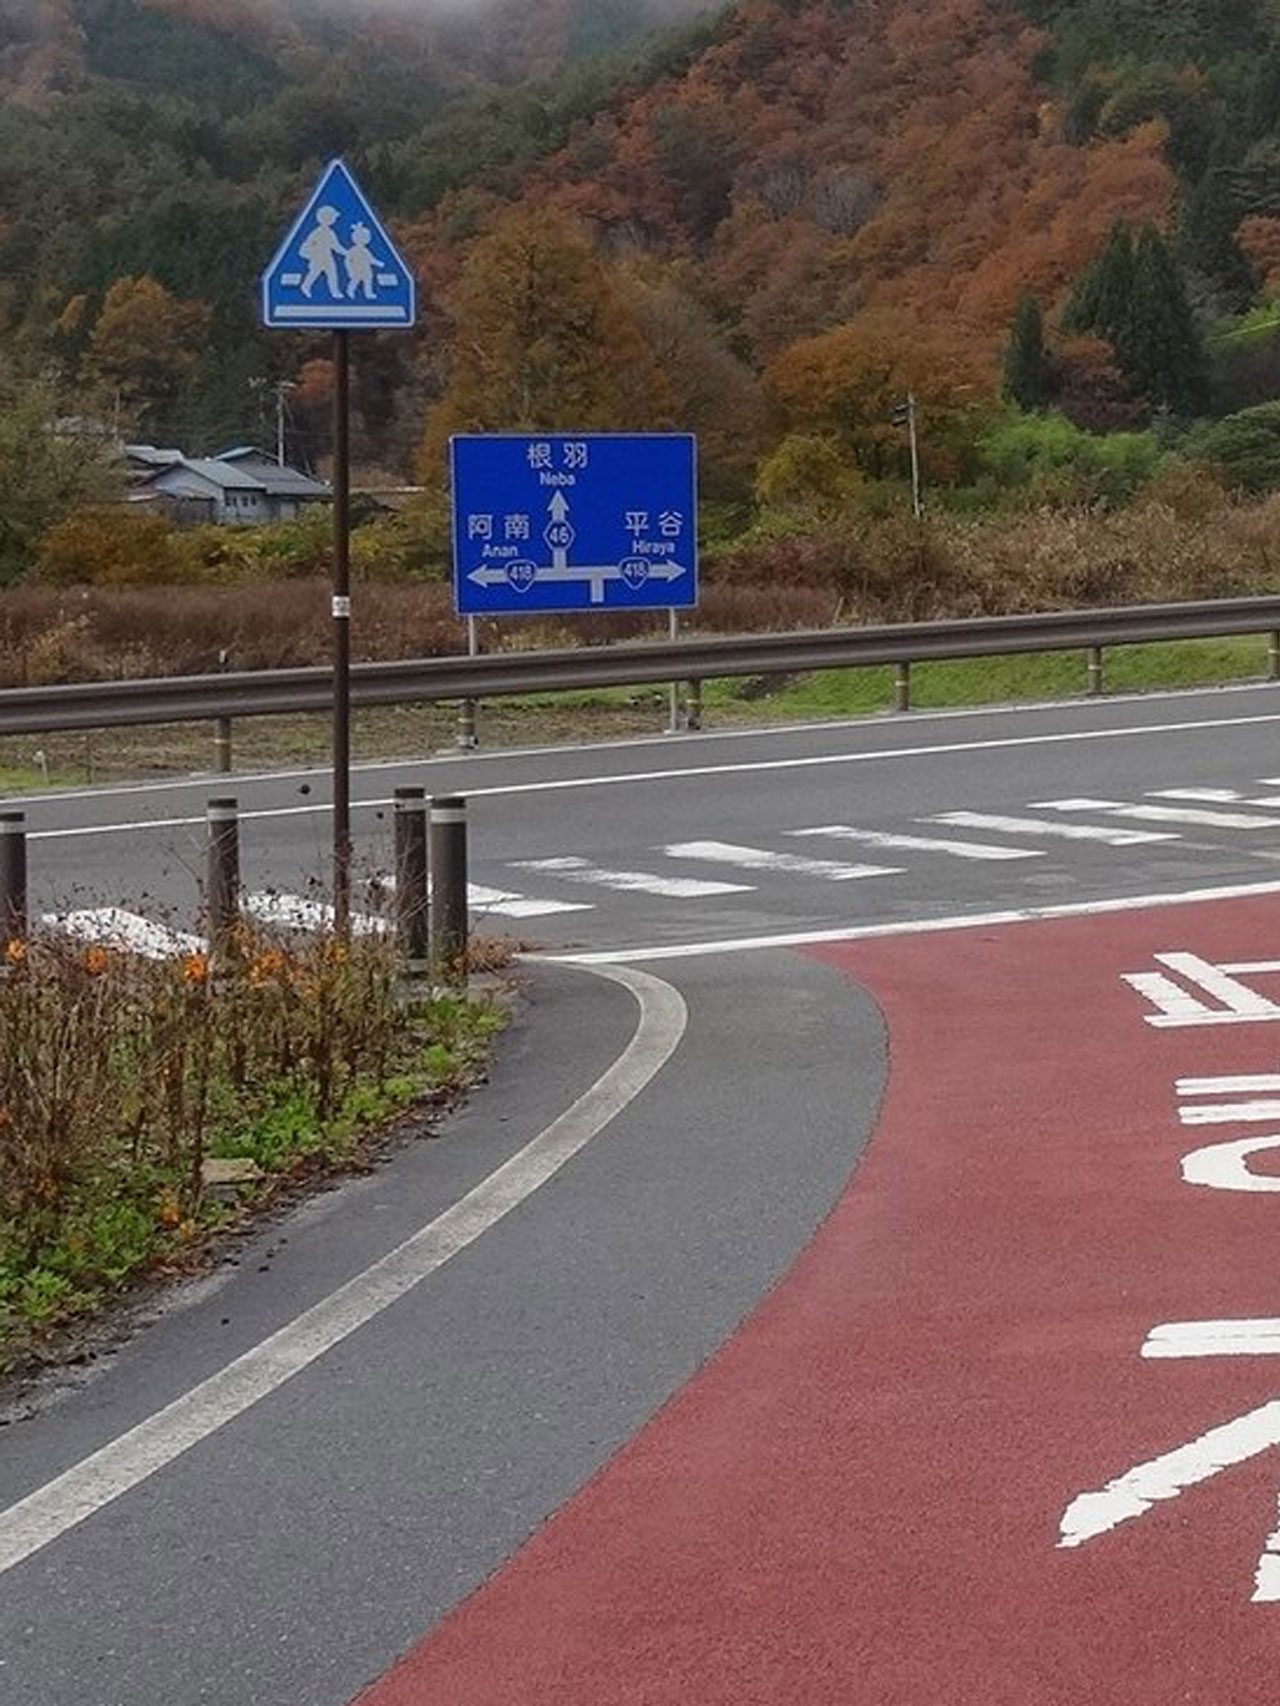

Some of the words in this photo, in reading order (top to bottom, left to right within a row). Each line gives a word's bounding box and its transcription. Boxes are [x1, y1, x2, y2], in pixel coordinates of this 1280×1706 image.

[527, 443, 588, 468] 根羽
[539, 472, 576, 487] Neba
[468, 514, 530, 539] 阿南
[625, 511, 683, 537] 平谷
[549, 526, 570, 544] 46
[482, 544, 518, 557] Anan
[632, 540, 675, 554] Hiraya
[510, 566, 532, 581] 418
[624, 562, 646, 578] 418
